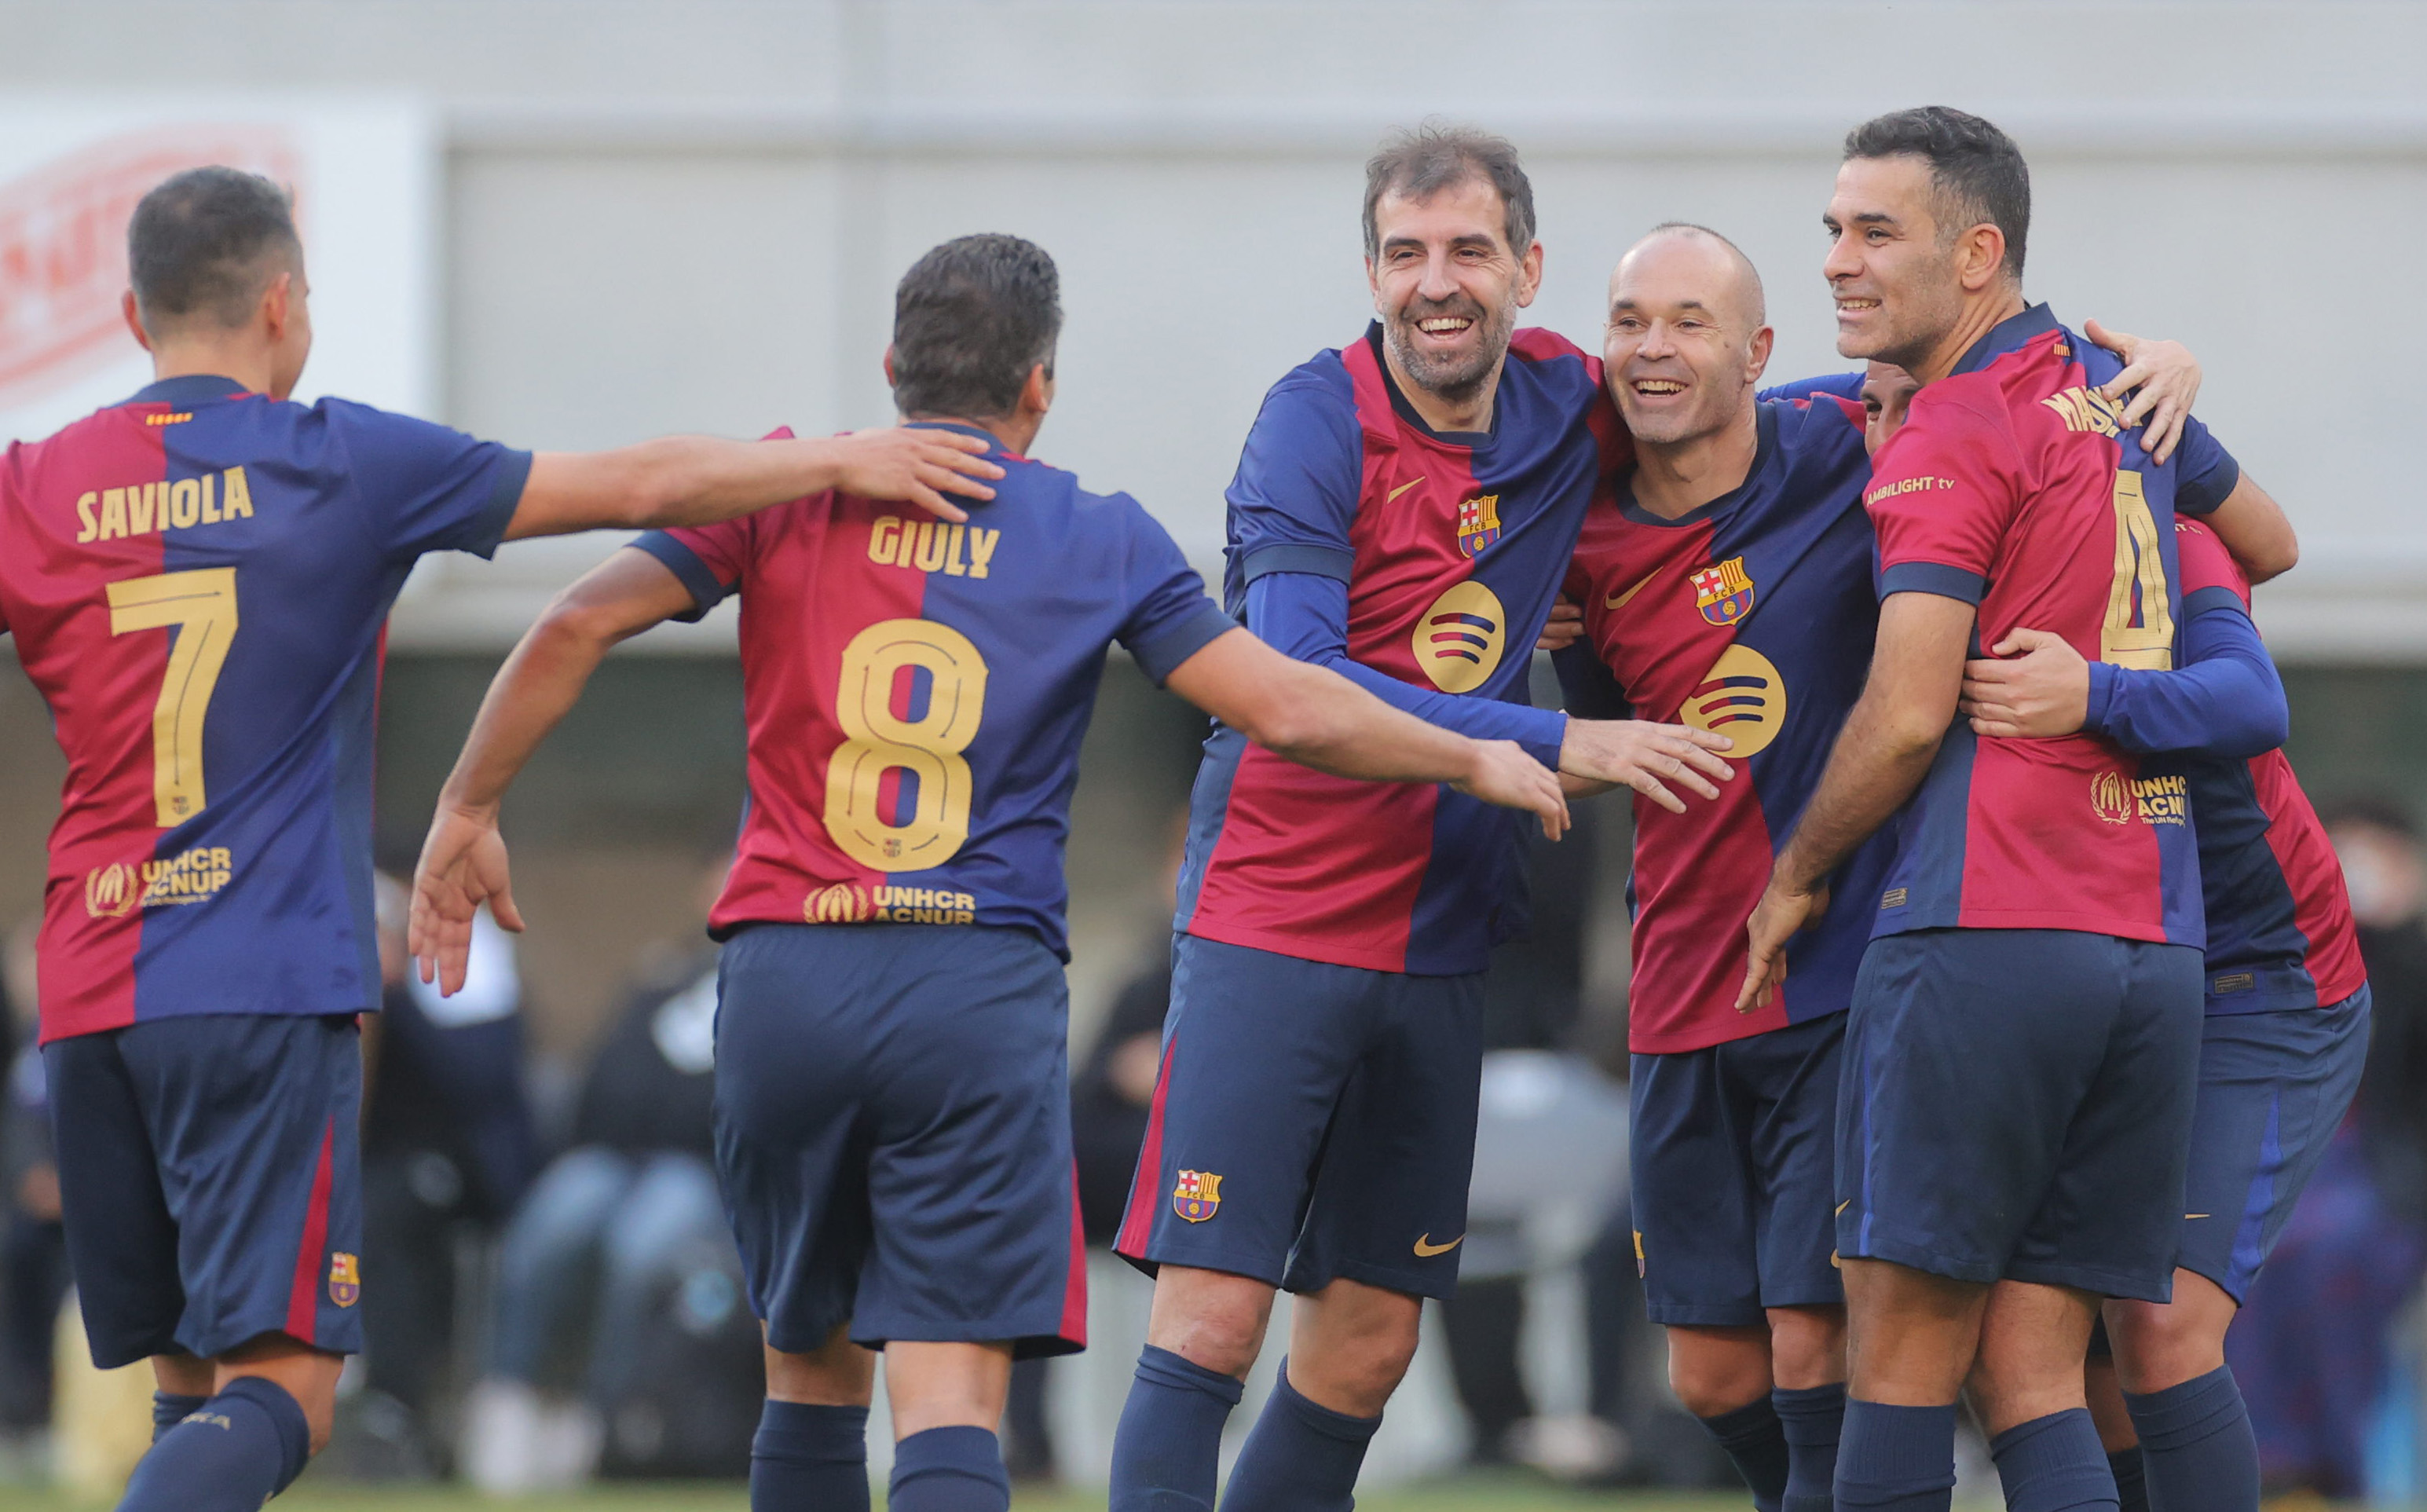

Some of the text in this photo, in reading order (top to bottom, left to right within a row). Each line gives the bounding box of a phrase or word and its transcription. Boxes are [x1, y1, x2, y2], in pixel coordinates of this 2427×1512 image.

[76, 465, 254, 544] SAVIOLA
[1866, 476, 1955, 508] AMBILIGHT tv
[1470, 522, 1486, 533] FCB
[868, 515, 1001, 579] GIULY
[1713, 586, 1735, 601] FCB
[104, 566, 239, 828] 7
[822, 617, 990, 873] 8
[2138, 796, 2185, 817] ACN
[873, 885, 976, 910] UNHCR
[874, 908, 975, 925] ACNUR
